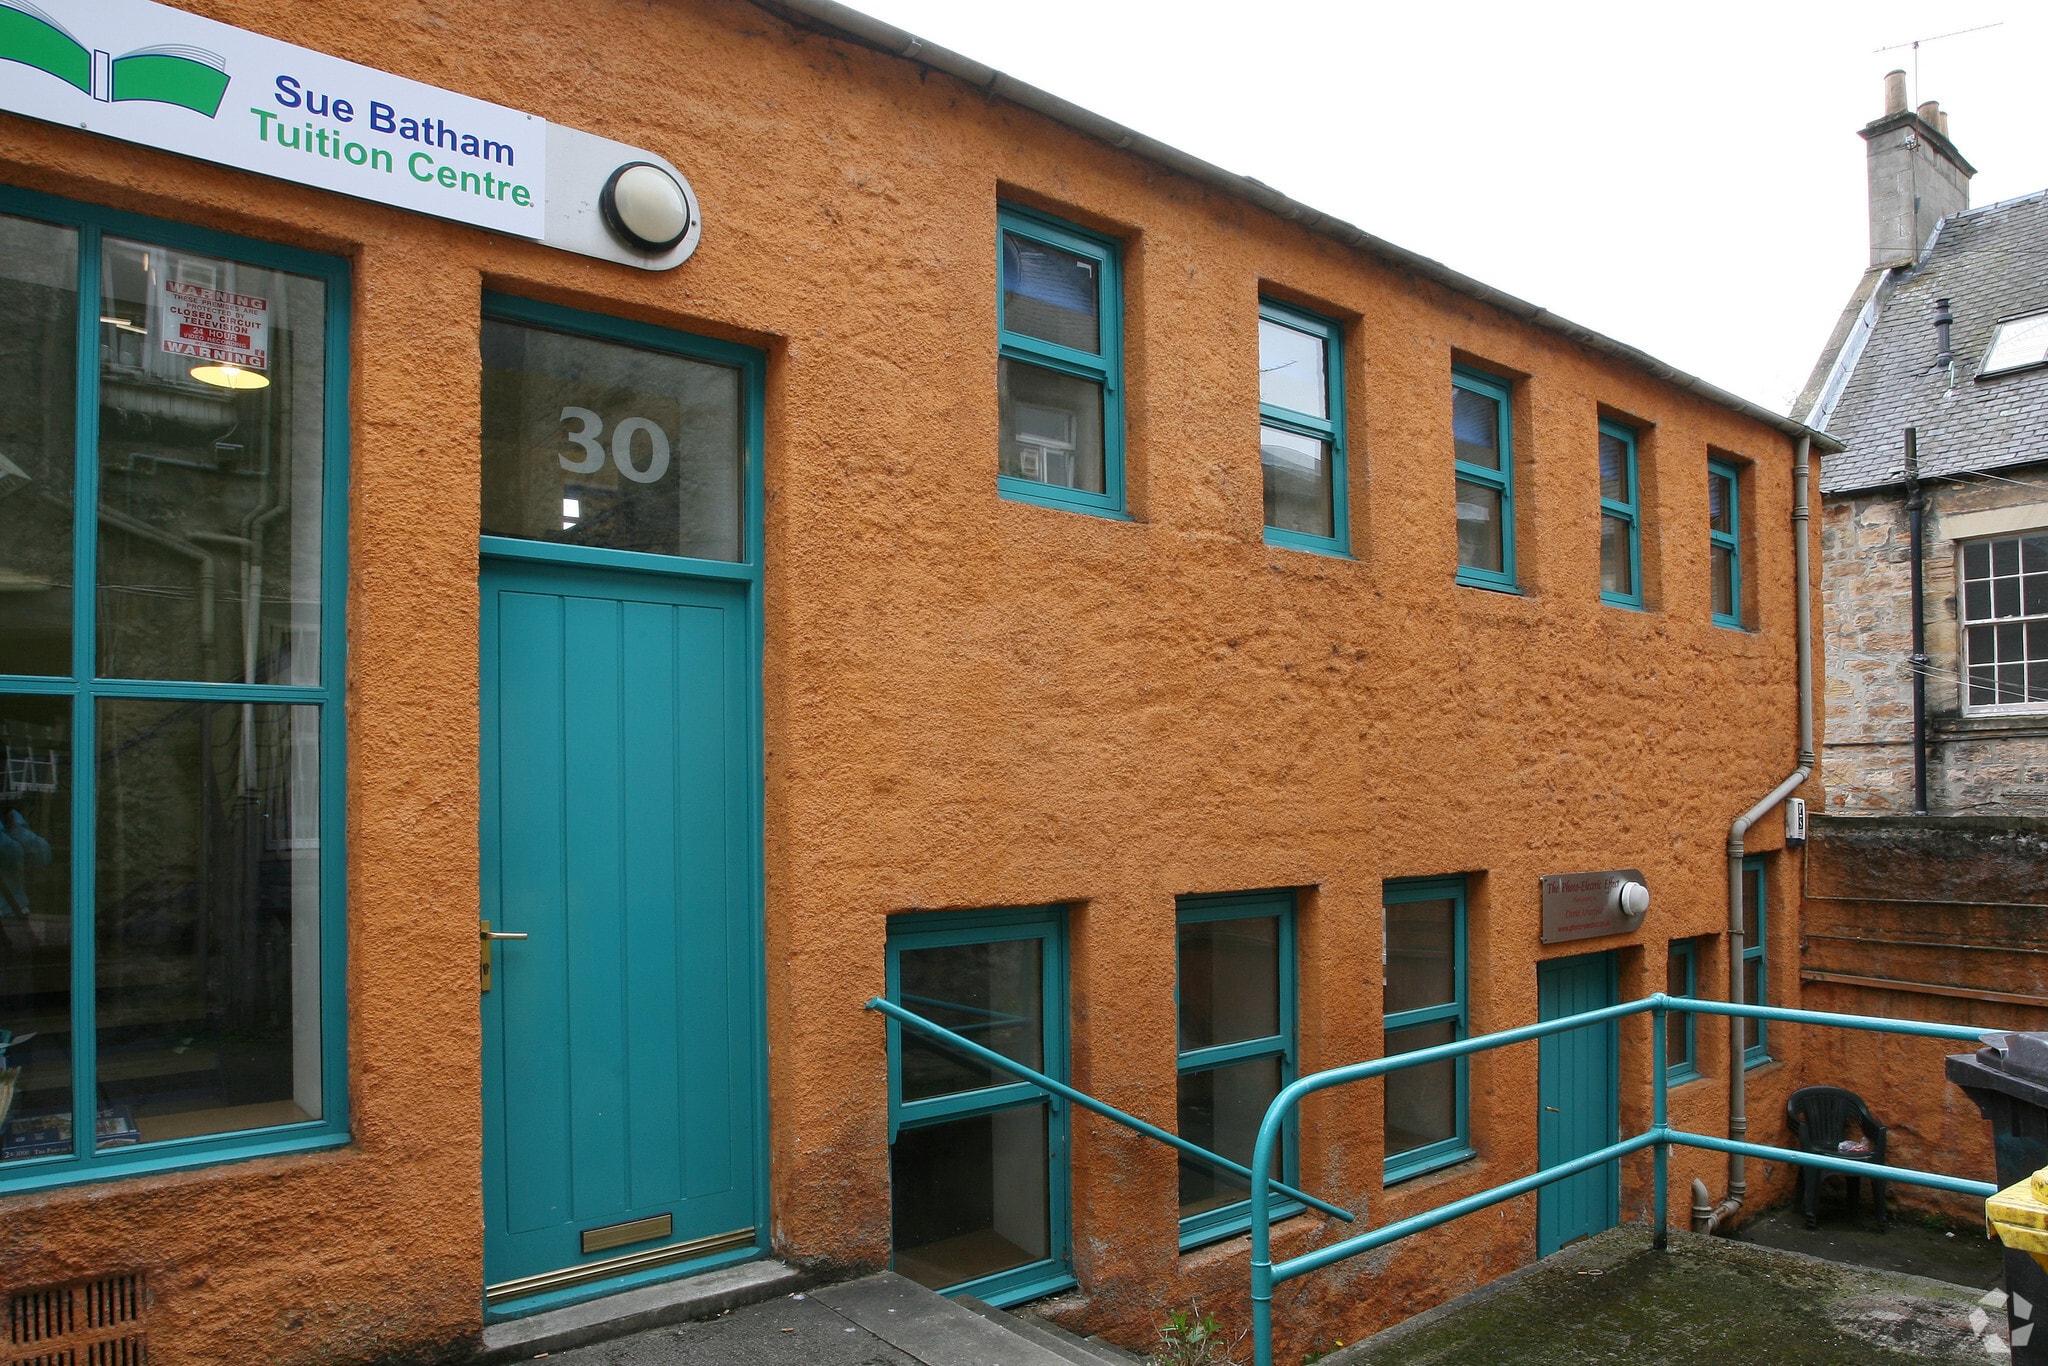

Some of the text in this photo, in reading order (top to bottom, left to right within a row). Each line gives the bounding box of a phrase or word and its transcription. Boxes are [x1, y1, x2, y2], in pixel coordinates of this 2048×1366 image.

[274, 75, 515, 166] Sue Batham
[250, 107, 531, 207] Tuition Centre
[168, 281, 263, 309] WARNING
[172, 293, 258, 316] THESE PREMISES ARE
[170, 306, 262, 329] CLOSED CIRCUIT
[186, 303, 231, 316] PROTECTED
[184, 316, 248, 334] TELEVISION
[193, 327, 238, 342] 24 HOUR
[184, 333, 247, 348] VIDEO RECORDING
[167, 341, 262, 367] WARNING
[558, 406, 670, 484] 30
